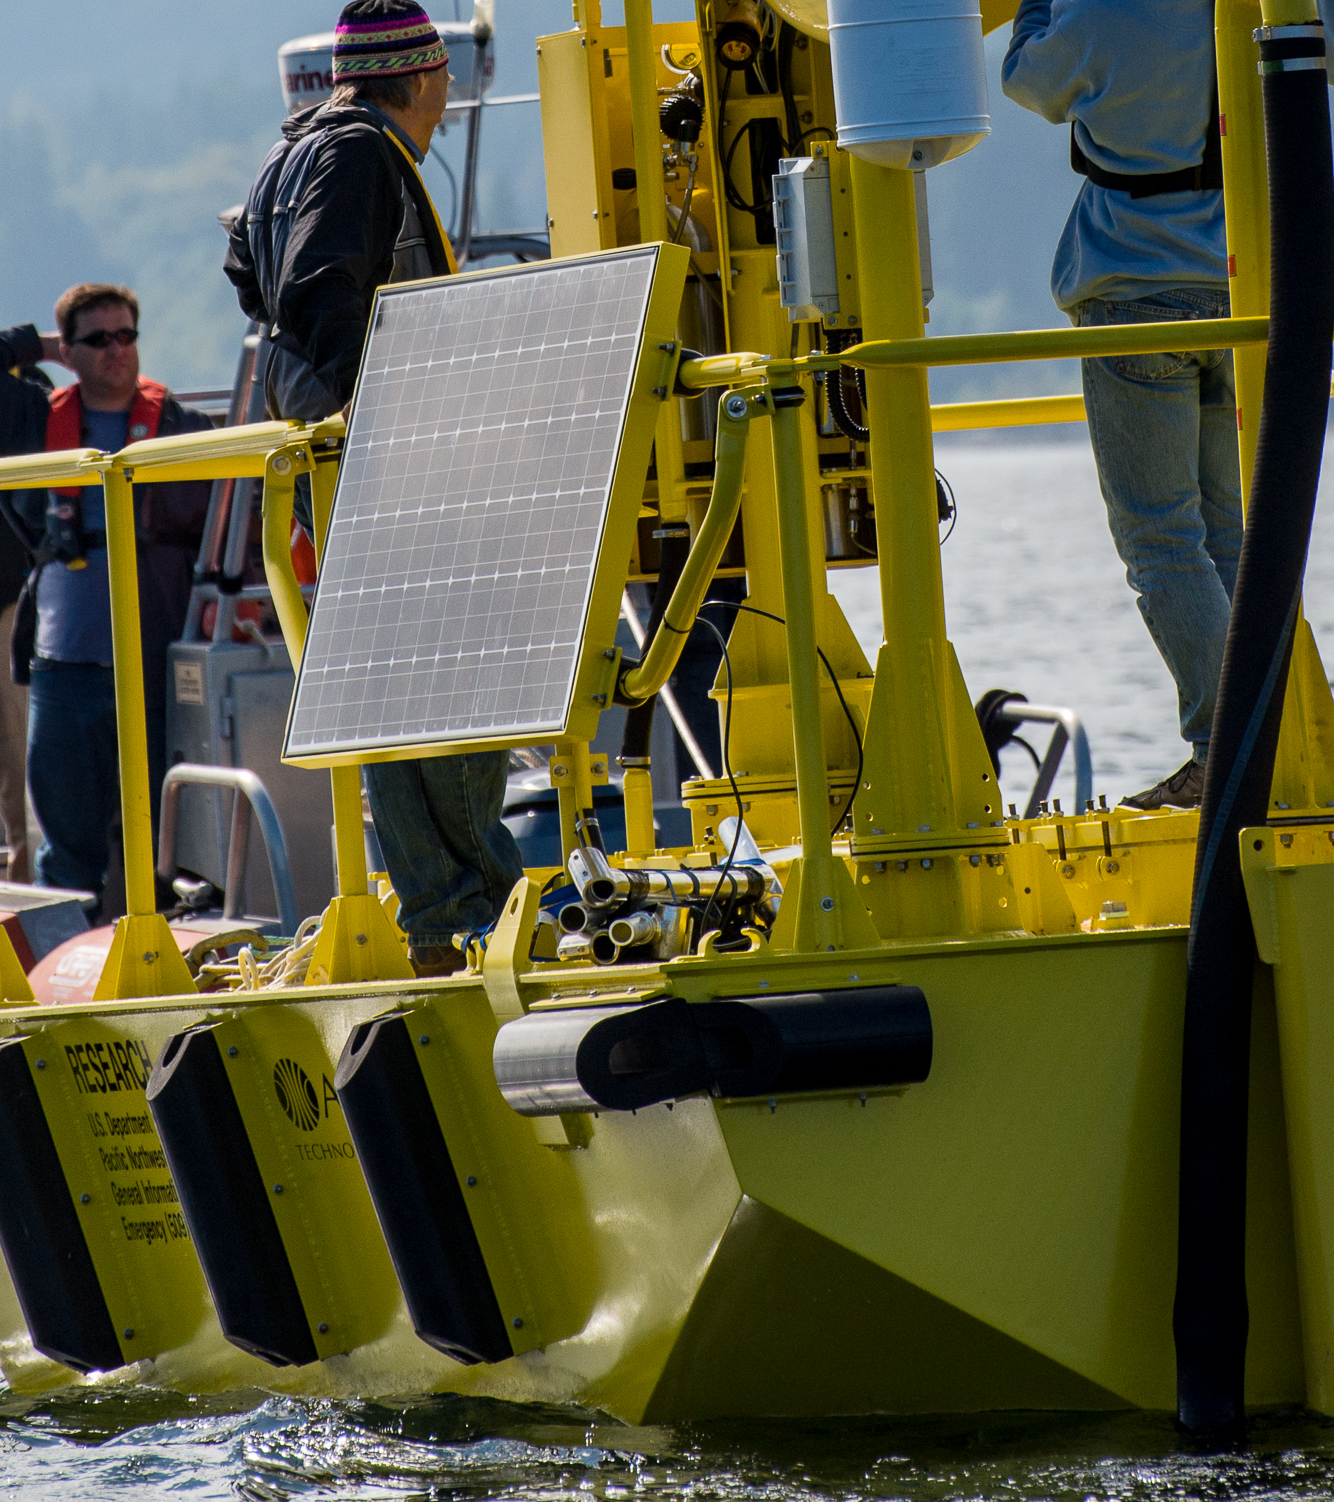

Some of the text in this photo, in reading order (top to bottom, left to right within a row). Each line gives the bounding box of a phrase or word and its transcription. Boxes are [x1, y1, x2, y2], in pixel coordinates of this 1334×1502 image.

[64, 1039, 153, 1094] RESEARCH
[87, 1110, 154, 1141] U.S. Department
[98, 1146, 129, 1172] Pacific
[295, 1142, 355, 1161] TECHNO
[111, 1180, 145, 1207] General
[121, 1215, 168, 1246] Emergency
